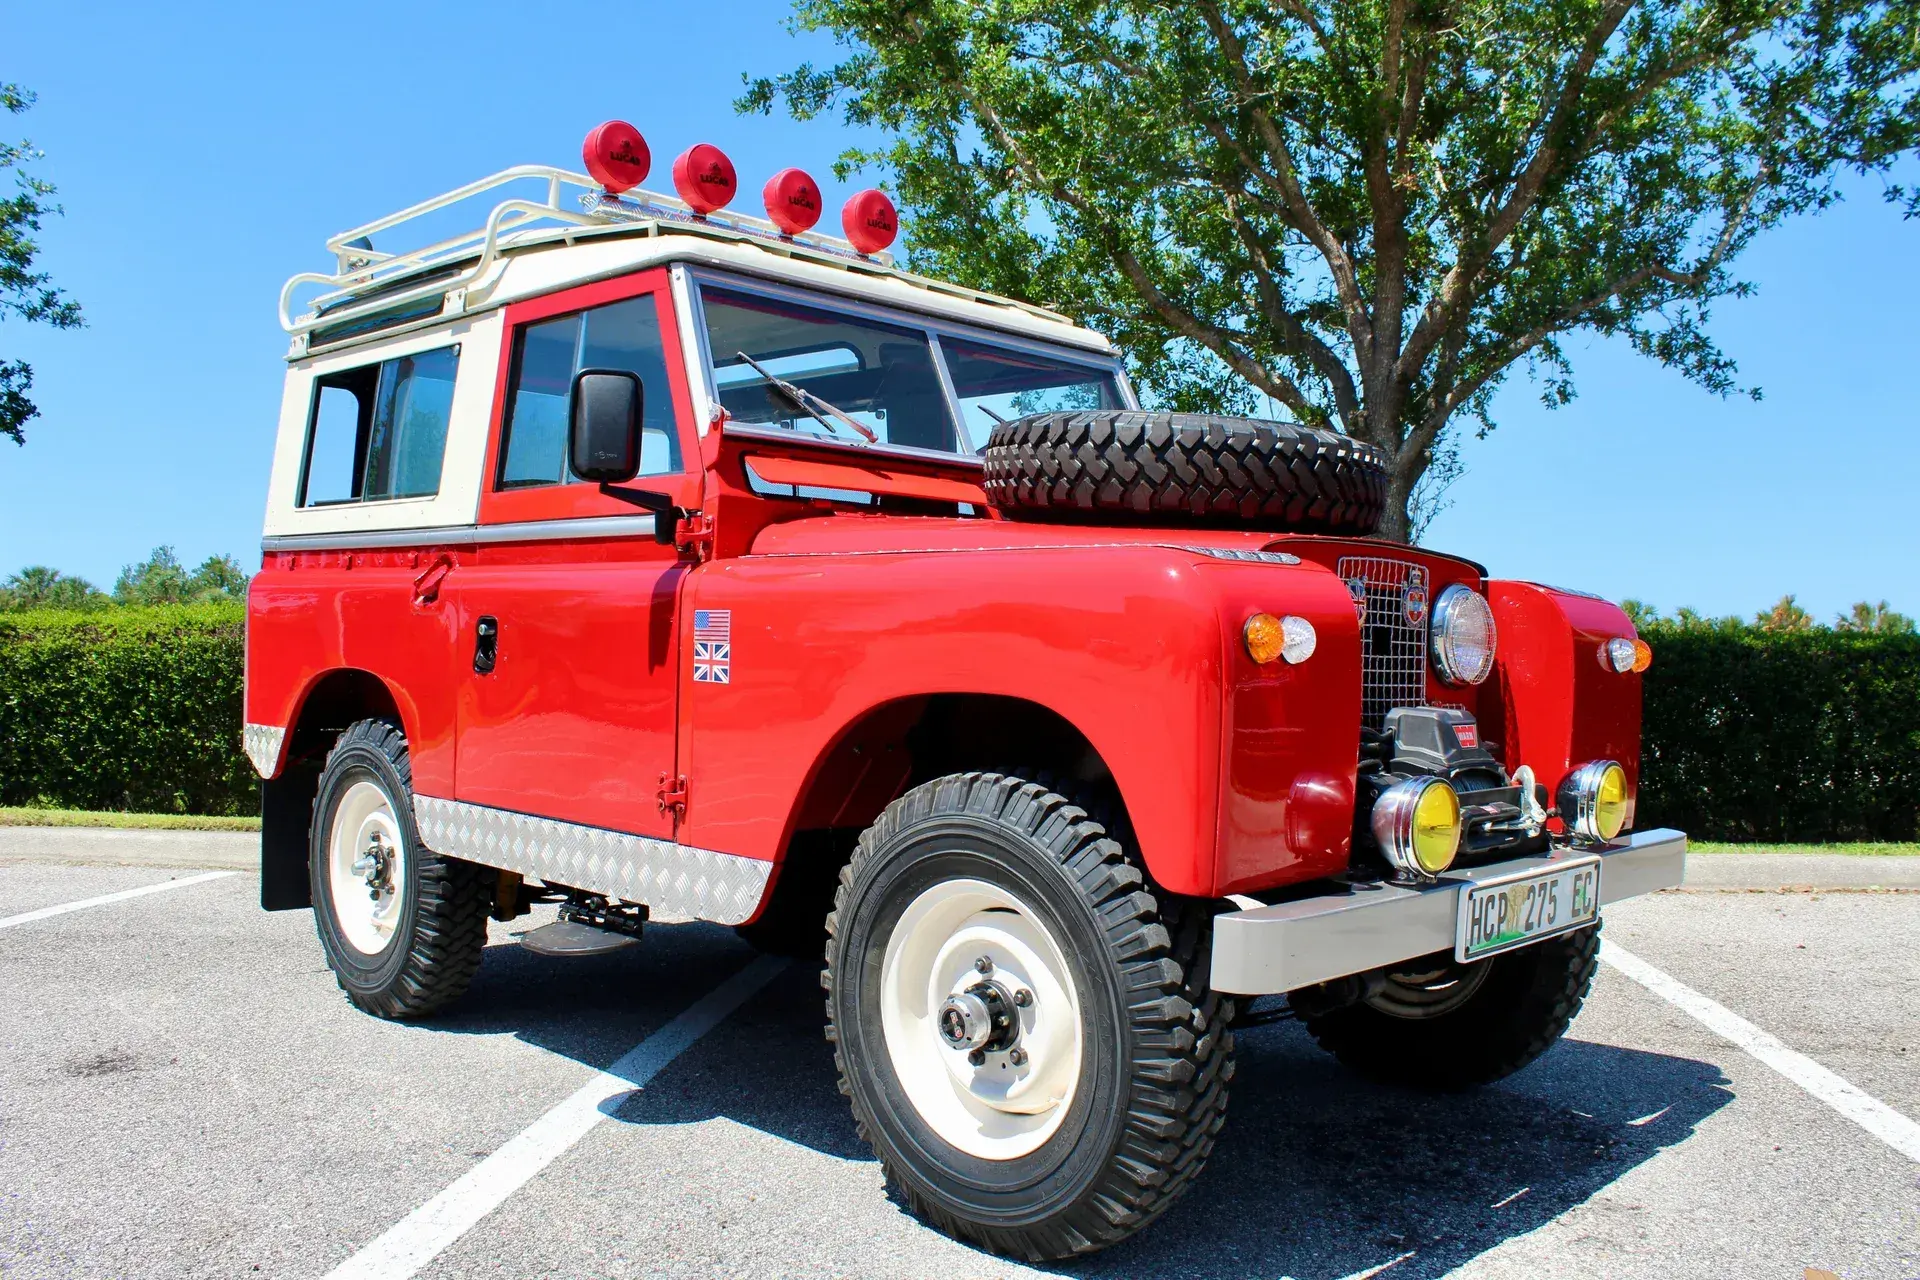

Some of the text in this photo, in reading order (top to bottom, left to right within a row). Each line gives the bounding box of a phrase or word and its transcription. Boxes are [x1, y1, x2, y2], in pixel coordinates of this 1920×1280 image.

[609, 150, 641, 166] LUCAS
[866, 217, 892, 232] LUCAS
[1469, 871, 1593, 947] HCP 275 EC
